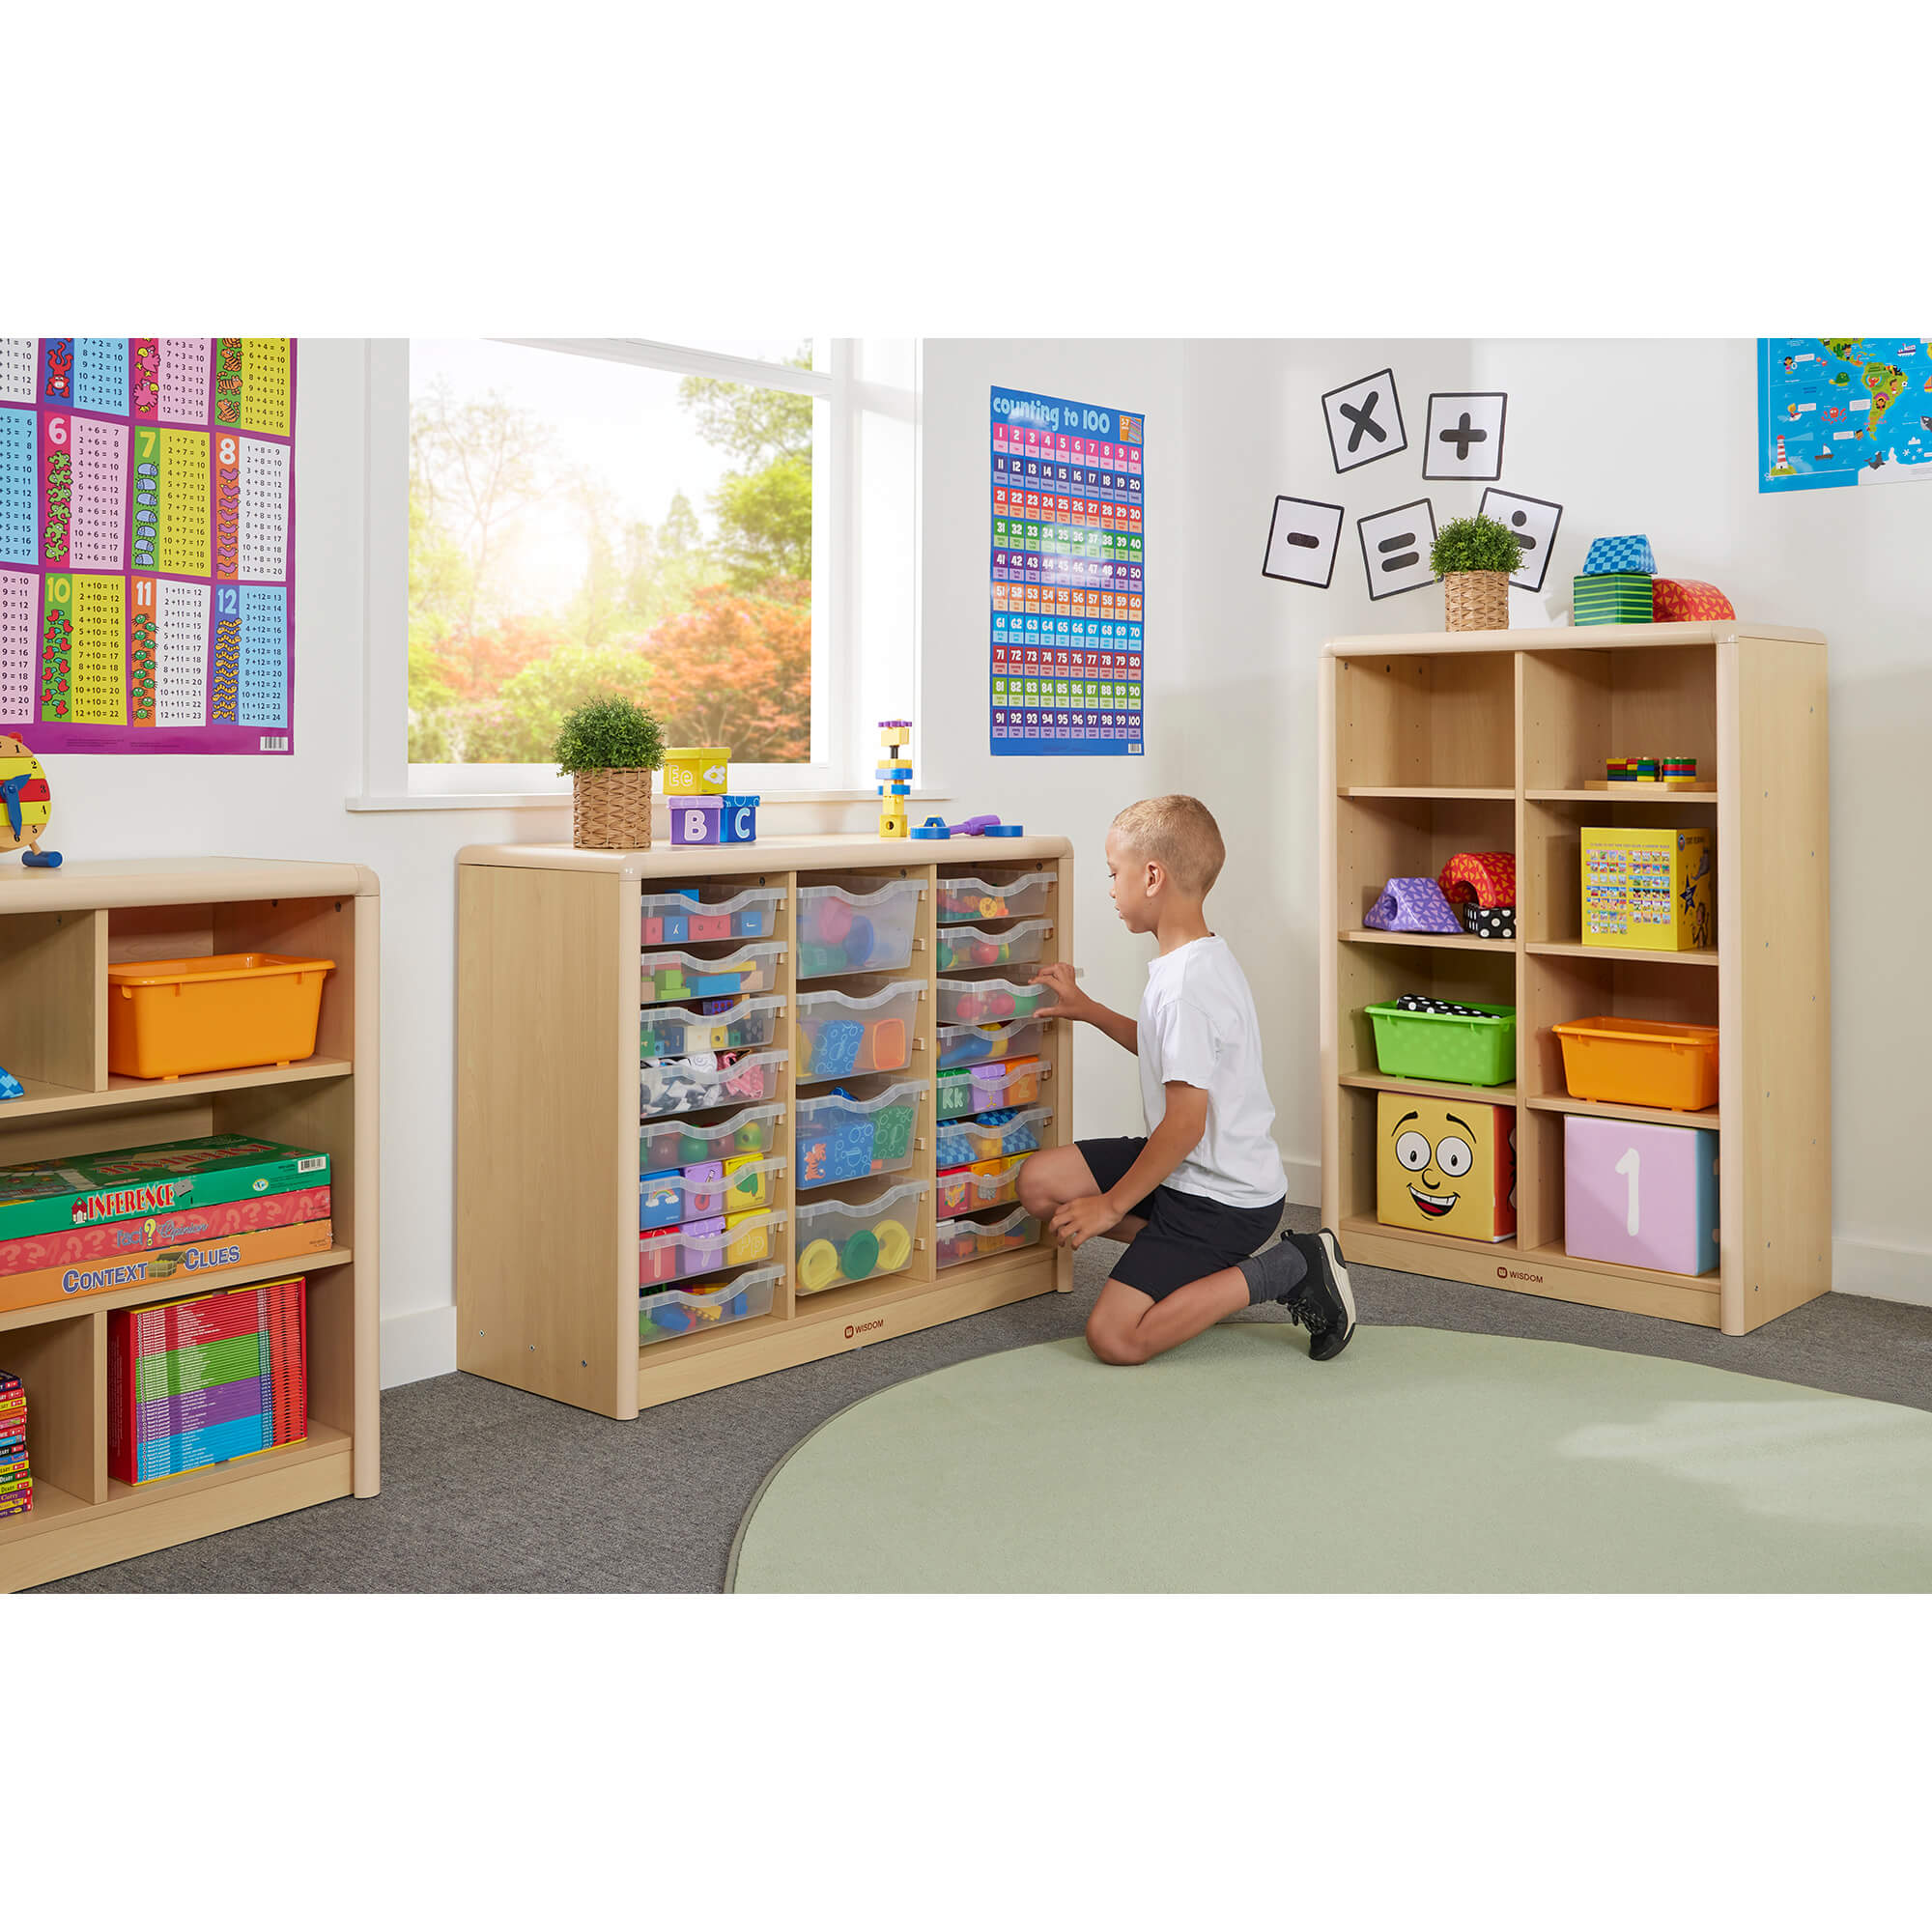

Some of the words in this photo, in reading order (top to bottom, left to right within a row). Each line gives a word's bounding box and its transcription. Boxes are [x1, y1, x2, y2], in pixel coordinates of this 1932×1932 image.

[993, 397, 1060, 432] counting
[1064, 407, 1079, 427] to
[1083, 409, 1111, 434] 100
[47, 417, 68, 444] 6
[139, 431, 156, 459] 7
[219, 438, 237, 466] 8
[1013, 429, 1020, 441] 2
[1029, 432, 1036, 443] 3
[1044, 435, 1051, 446] 4
[1060, 437, 1066, 449] 5
[1074, 440, 1081, 451] 6
[1089, 442, 1095, 453] 7
[1103, 445, 1110, 457] 8
[1118, 447, 1124, 459] 9
[1130, 449, 1140, 461] 10
[998, 458, 1004, 470] 11
[1011, 461, 1021, 472] 12
[1028, 463, 1037, 475] 13
[1042, 466, 1052, 477] 14
[1058, 468, 1067, 480] 15
[1073, 470, 1082, 482] 16
[1088, 472, 1096, 484] 17
[1102, 474, 1111, 487] 18
[1117, 476, 1125, 488] 19
[1129, 478, 1141, 491] 20
[996, 490, 1006, 501] 21
[1010, 492, 1023, 504] 22
[1027, 494, 1038, 506] 23
[1042, 496, 1054, 508] 24
[1058, 497, 1069, 511] 25
[1072, 499, 1084, 513] 26
[1088, 502, 1098, 514] 27
[1101, 504, 1113, 517] 28
[1116, 506, 1127, 518] 29
[1129, 508, 1141, 521] 30
[46, 577, 71, 604] 10
[135, 581, 152, 607] 11
[217, 588, 238, 614] 12
[1027, 587, 1038, 600] 53
[1042, 588, 1054, 601] 54
[1058, 590, 1069, 603] 55
[1072, 591, 1084, 604] 56
[1088, 592, 1098, 605] 57
[1102, 594, 1114, 606] 58
[1116, 596, 1127, 607] 59
[1129, 597, 1142, 609] 60
[996, 617, 1006, 628] 61
[1010, 617, 1023, 629] 62
[1026, 619, 1038, 631] 63
[1041, 620, 1054, 632] 64
[1057, 621, 1068, 633] 65
[1071, 622, 1084, 634] 66
[1087, 624, 1098, 635] 67
[1101, 625, 1113, 636] 68
[1116, 625, 1126, 637] 69
[1129, 627, 1141, 638] 70
[996, 648, 1005, 660] 71
[1010, 649, 1022, 661] 72
[1026, 650, 1037, 662] 73
[1042, 651, 1052, 663] 74
[1057, 652, 1067, 664] 75
[1071, 653, 1083, 665] 76
[1087, 654, 1097, 666] 77
[1102, 655, 1112, 666] 78
[1116, 655, 1126, 667] 79
[1129, 656, 1141, 668] 80
[995, 712, 1005, 724] 91
[1009, 712, 1022, 724] 92
[1026, 713, 1038, 724] 93
[1041, 713, 1054, 724] 94
[1057, 714, 1068, 725] 95
[1071, 714, 1084, 725] 96
[1087, 714, 1098, 725] 97
[1101, 714, 1113, 725] 98
[1116, 715, 1126, 725] 99
[1128, 716, 1141, 726] 100
[14, 744, 20, 753] 1
[31, 760, 37, 769] 2
[668, 764, 694, 787] Ee
[40, 784, 46, 793] 3
[32, 825, 38, 834] 5
[683, 810, 708, 841] B
[734, 808, 751, 838] C
[87, 1182, 175, 1221] INFERENCE
[1614, 1147, 1640, 1236] 1
[62, 1262, 149, 1293] CONTEXT
[184, 1245, 241, 1271] CLUES
[1509, 1270, 1544, 1284] WISDOM
[855, 1319, 884, 1334] WISDOM
